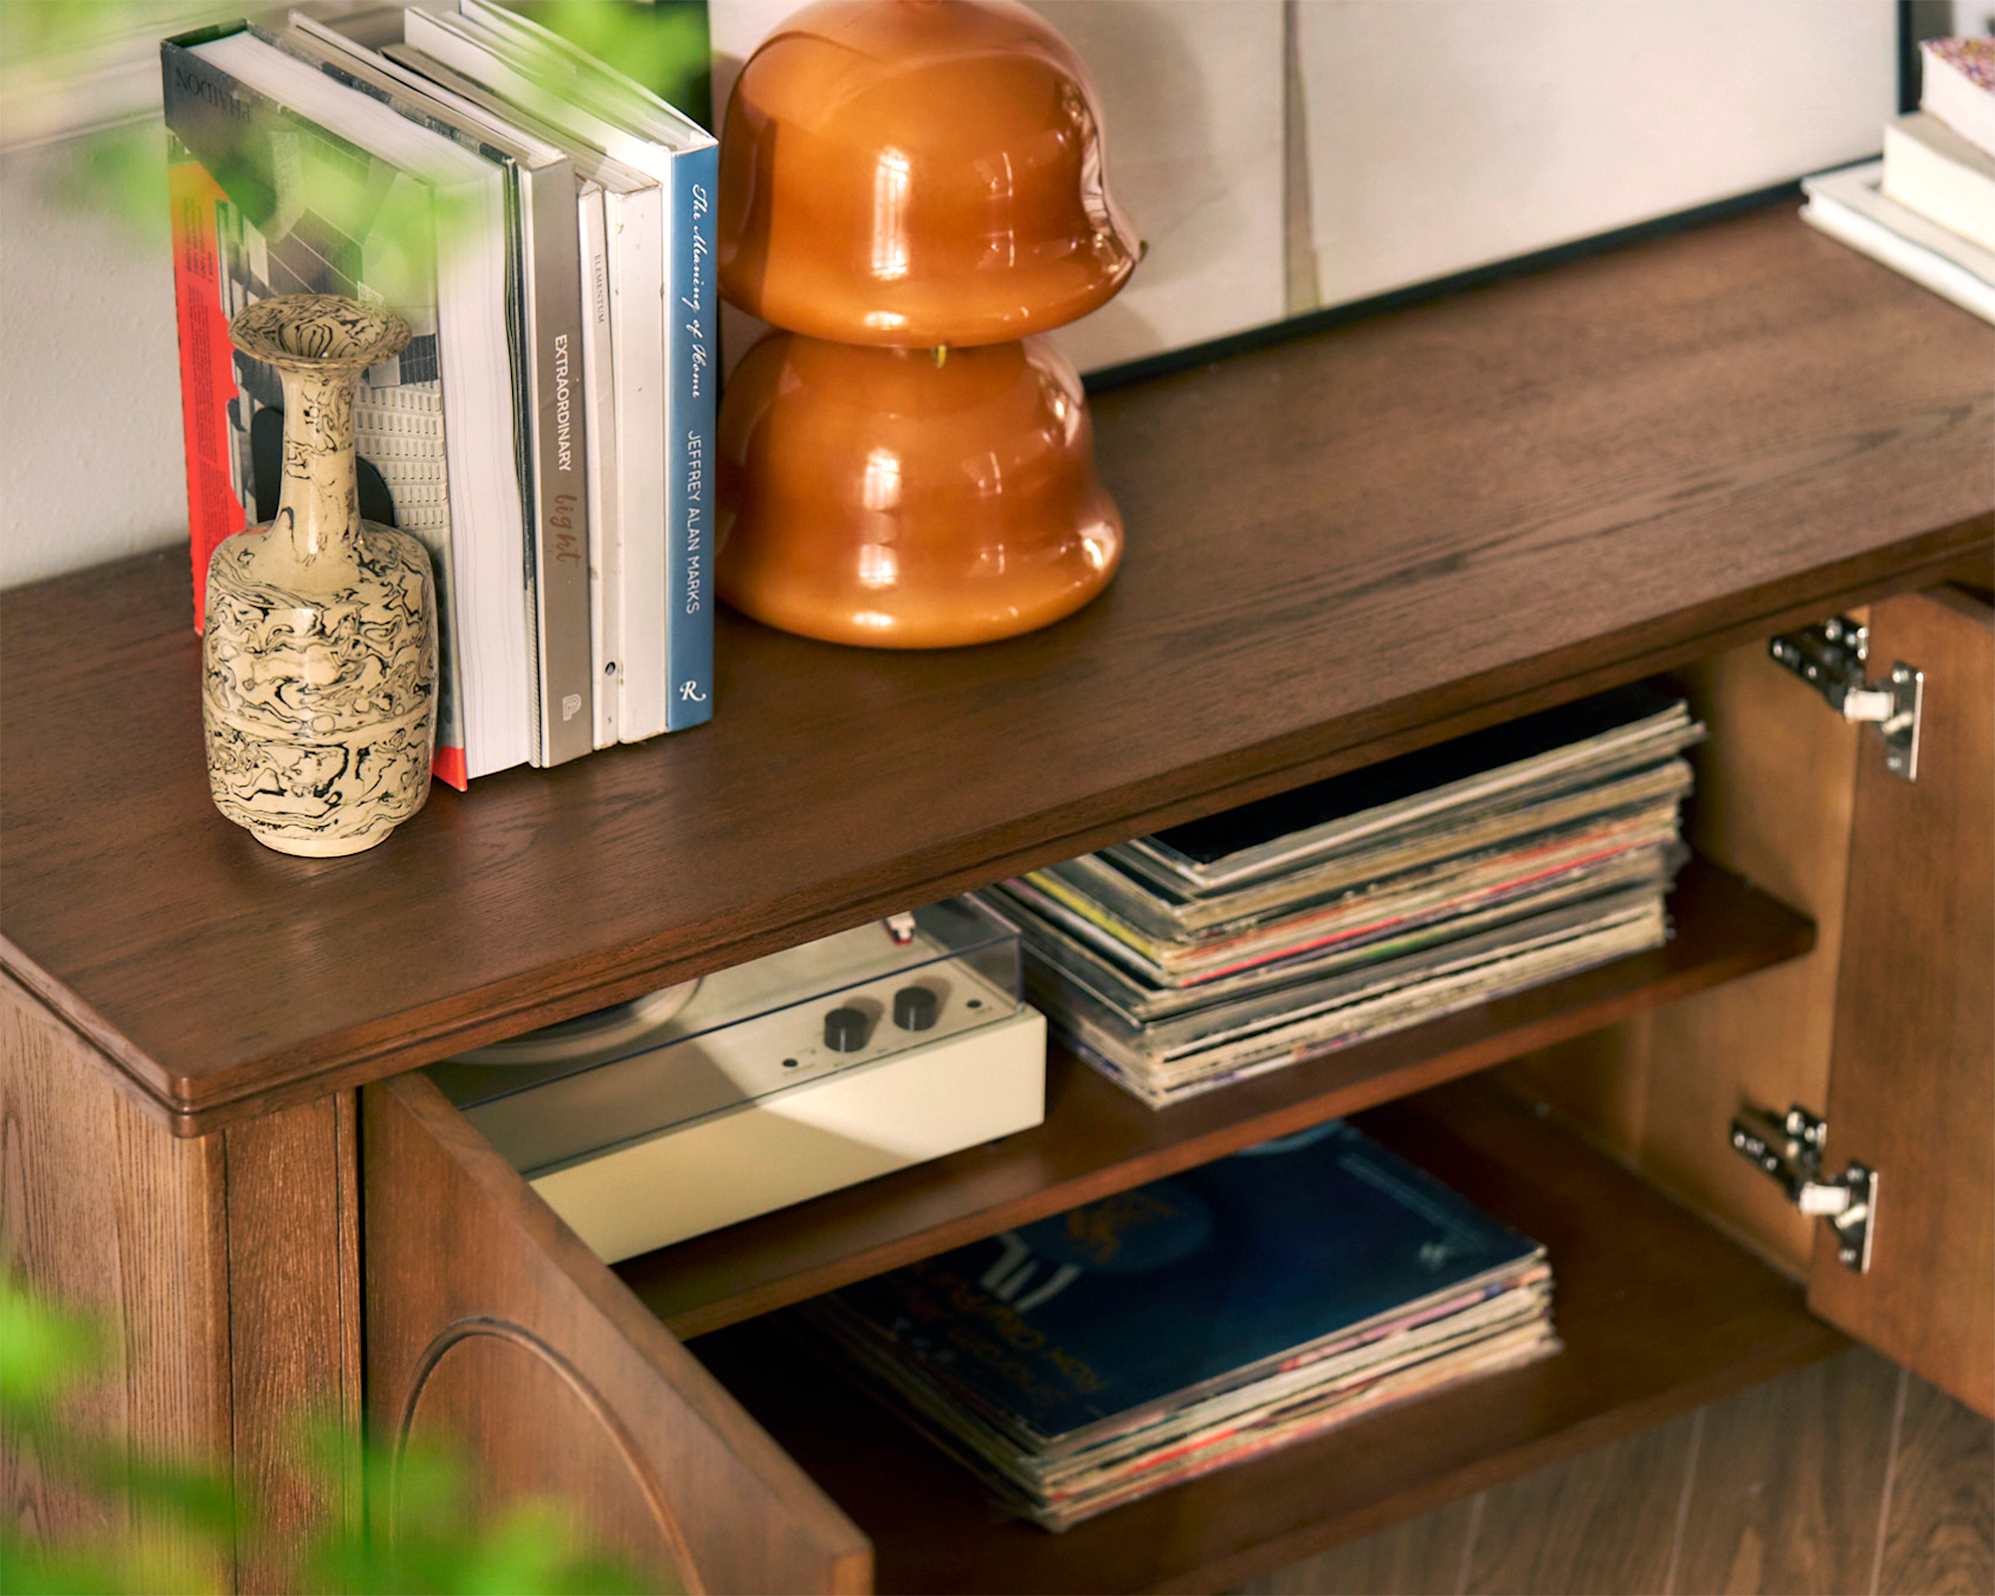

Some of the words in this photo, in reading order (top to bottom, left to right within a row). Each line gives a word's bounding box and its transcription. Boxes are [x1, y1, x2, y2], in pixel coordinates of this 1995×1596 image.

[692, 183, 707, 220] The
[594, 254, 605, 323] ELEMENTUM
[682, 225, 707, 313] Meaning
[686, 319, 703, 339] of
[555, 334, 571, 472] EXTRAORDINARY
[692, 344, 707, 399] Home
[688, 430, 701, 501] JEFFREY
[550, 494, 581, 565] light
[687, 507, 700, 551] ALAN
[686, 555, 700, 614] MARKS
